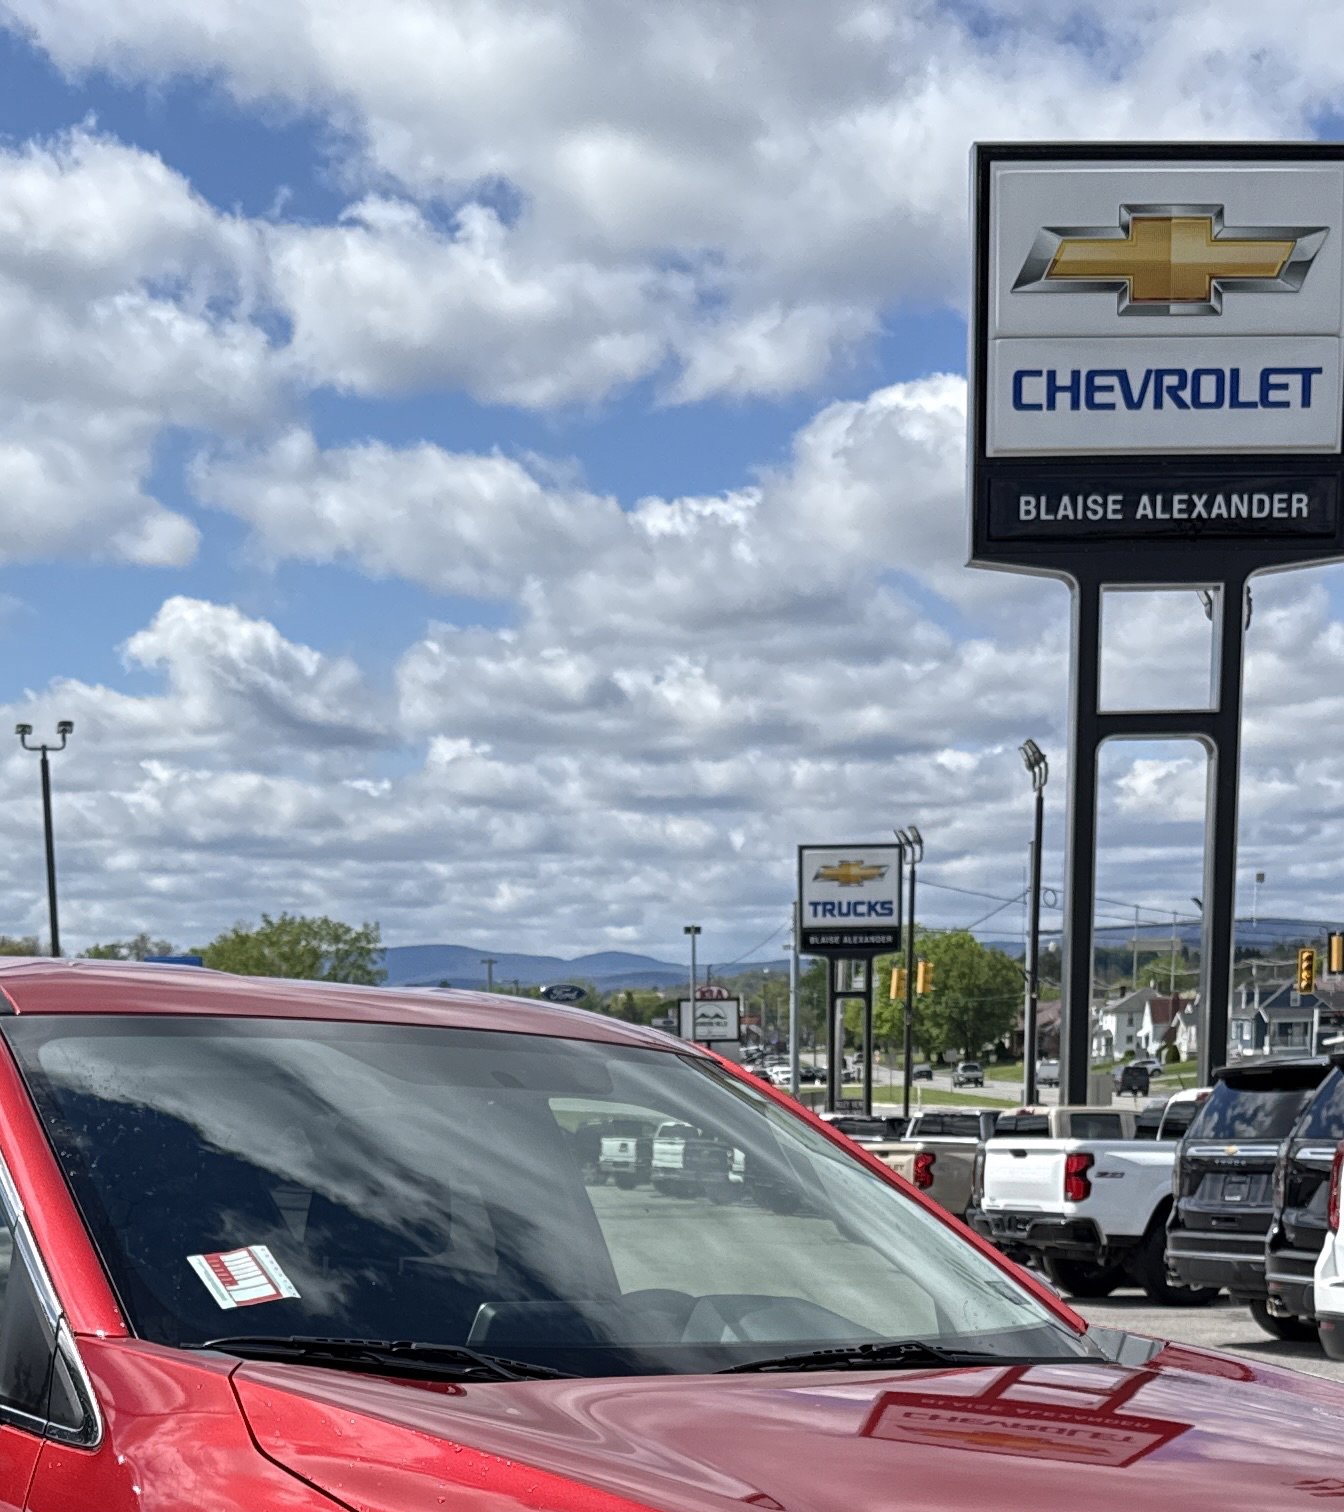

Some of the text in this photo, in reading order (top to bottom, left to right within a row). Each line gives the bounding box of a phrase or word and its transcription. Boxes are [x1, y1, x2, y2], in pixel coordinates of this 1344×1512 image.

[1012, 367, 1323, 411] CHEVROLET
[1019, 493, 1309, 521] BLAISE ALEXANDER
[808, 901, 894, 918] TRUCKS
[809, 935, 894, 945] BLAISE ALEXANDER
